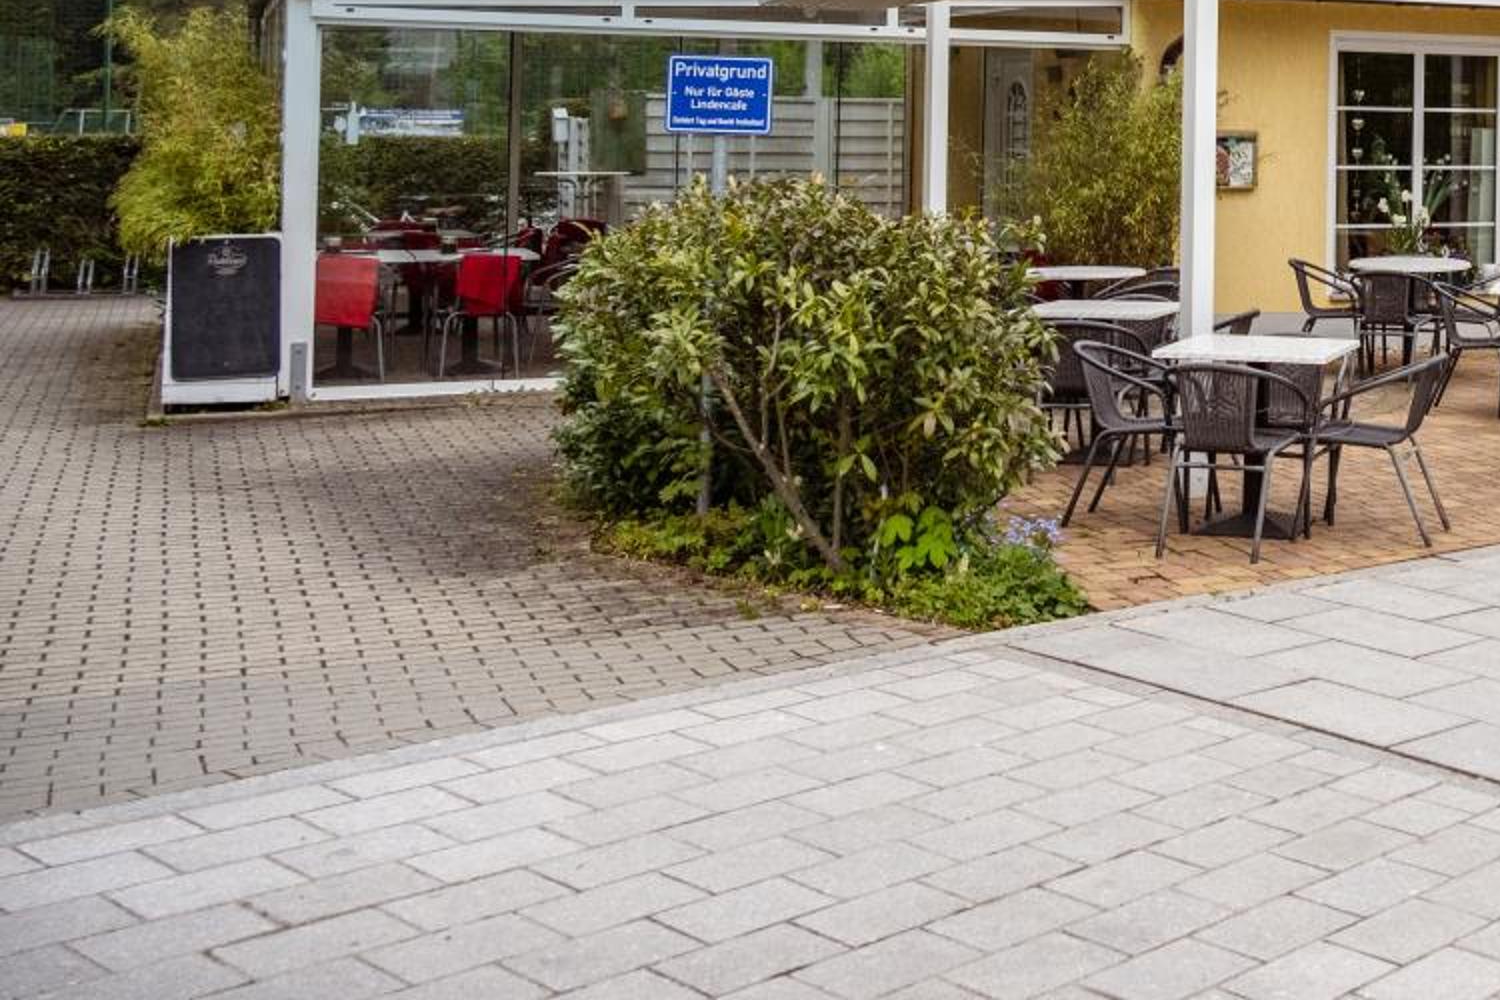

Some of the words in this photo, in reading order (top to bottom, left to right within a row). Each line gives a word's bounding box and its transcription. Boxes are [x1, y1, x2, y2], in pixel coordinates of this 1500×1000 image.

[675, 61, 767, 82] Privatgrund
[684, 85, 704, 97] Nur
[707, 85, 722, 97] für
[725, 86, 755, 99] Gäste
